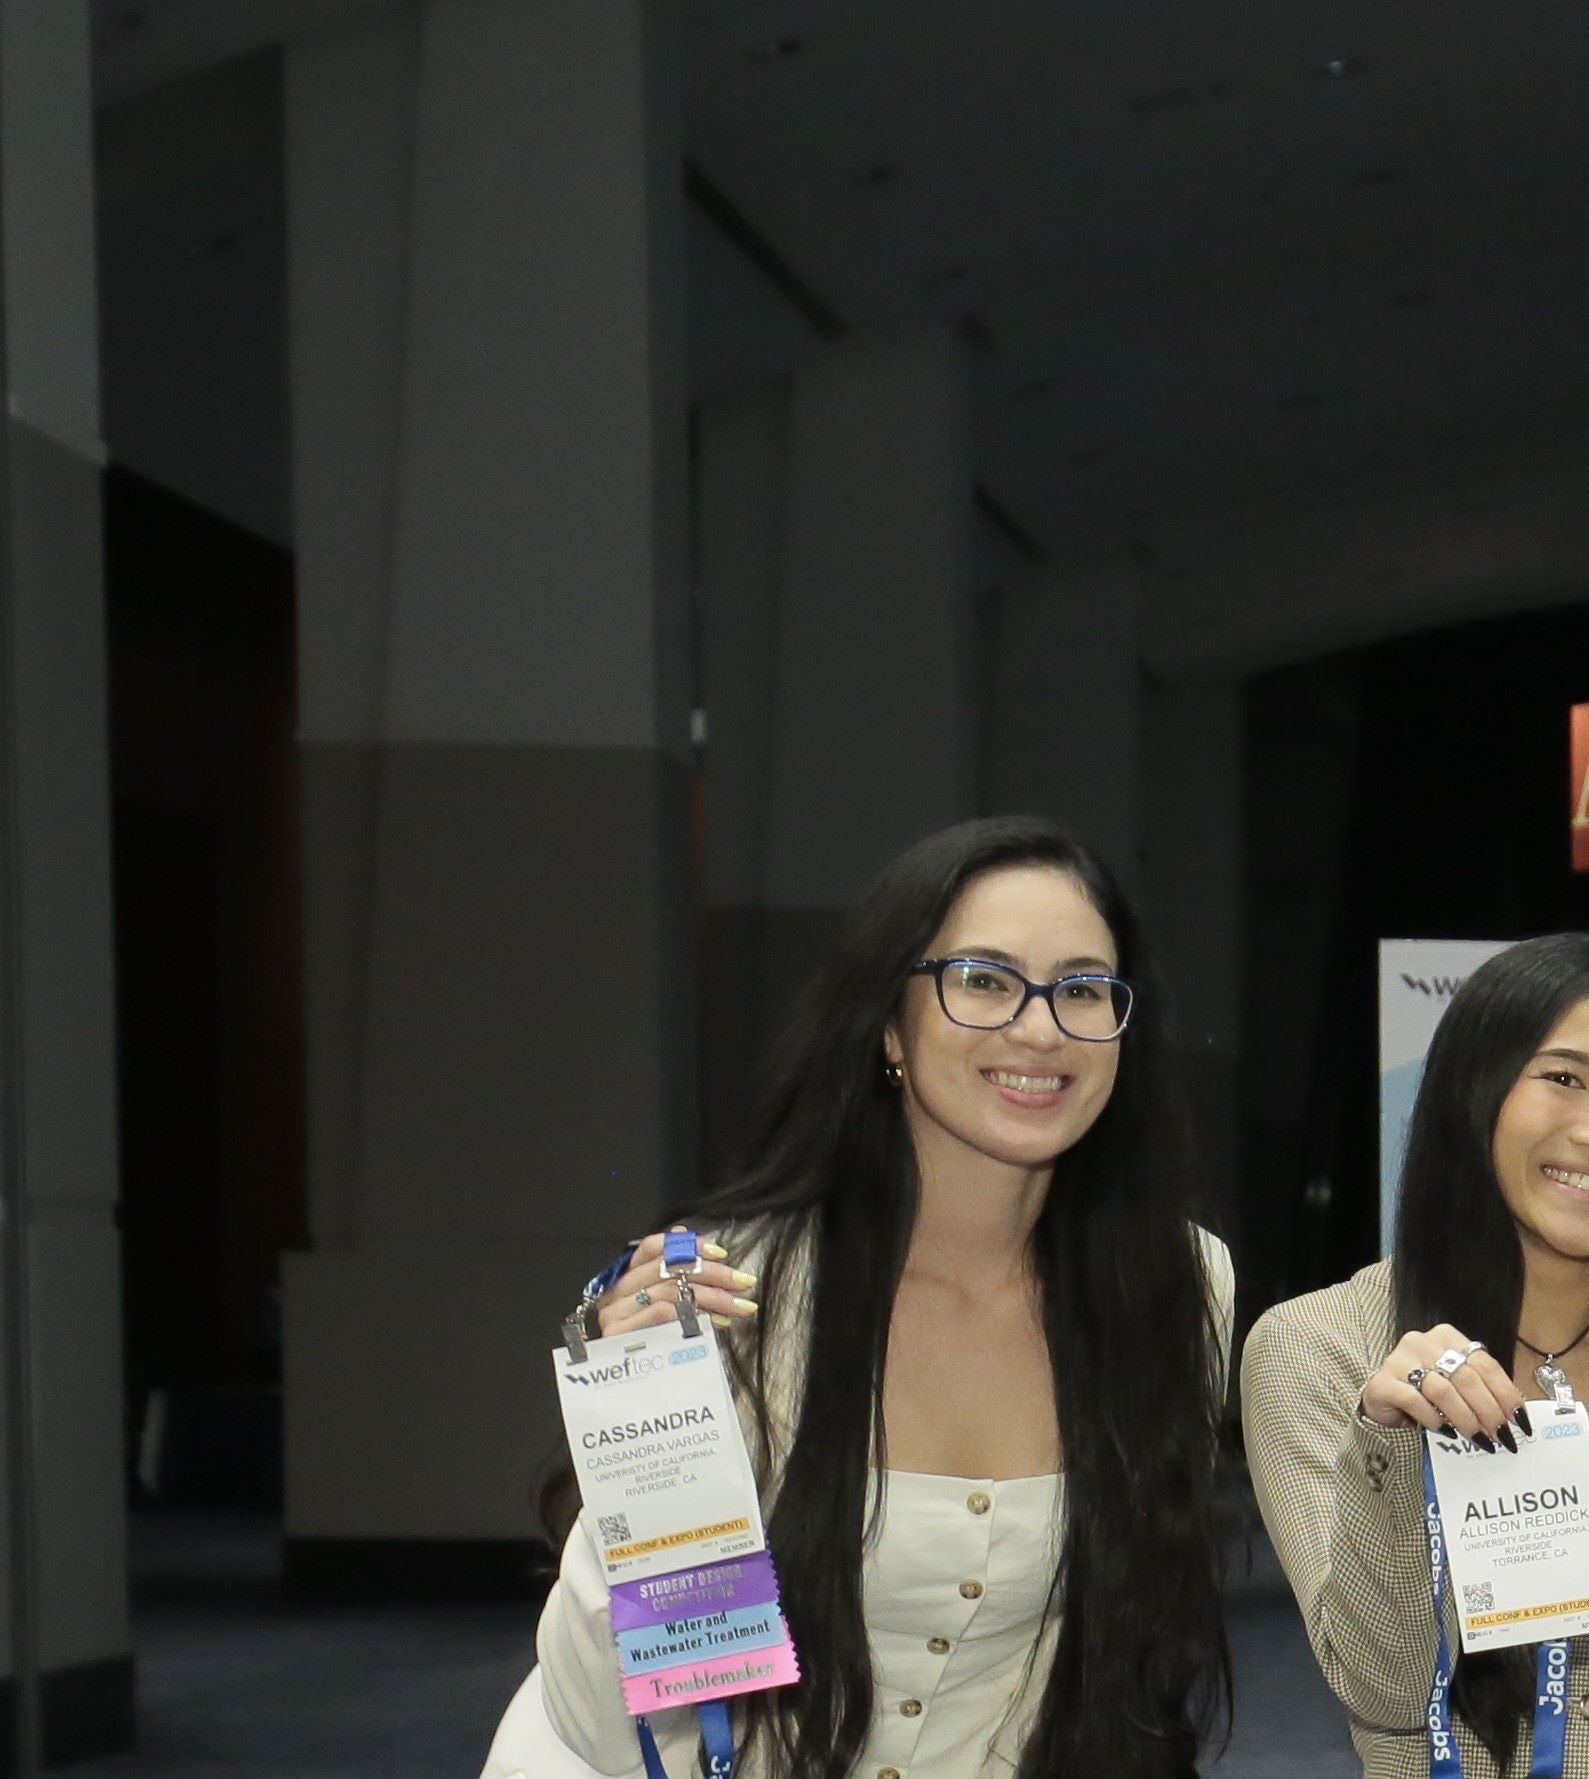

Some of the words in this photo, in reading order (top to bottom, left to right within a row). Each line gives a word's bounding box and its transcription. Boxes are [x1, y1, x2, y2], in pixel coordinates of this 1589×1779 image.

[582, 1406, 714, 1449] CASSANDRA
[1545, 1423, 1580, 1439] 2023
[586, 1442, 665, 1470] CASSANDRA
[683, 1473, 698, 1484] CA
[1464, 1485, 1579, 1522] ALLISON
[1460, 1519, 1520, 1539] ALLISON
[1525, 1508, 1589, 1528] REDDICK
[1464, 1536, 1517, 1551] UNIVERSITY
[1519, 1533, 1531, 1542] OF
[1533, 1525, 1587, 1540] CALIFORNIA
[1505, 1540, 1552, 1555] RIVERSIDE
[1554, 1549, 1568, 1558] CA
[640, 1574, 694, 1598] STUDENT
[665, 1619, 702, 1636] Water
[706, 1610, 728, 1626] and
[1471, 1615, 1493, 1626] FULL
[1496, 1611, 1520, 1621] CONF
[1533, 1605, 1557, 1616] EXPO
[631, 1638, 703, 1662] Wastewater
[705, 1619, 770, 1646] Treatment
[650, 1662, 774, 1698] Troublemaker
[1429, 1670, 1451, 1762] Jacobs
